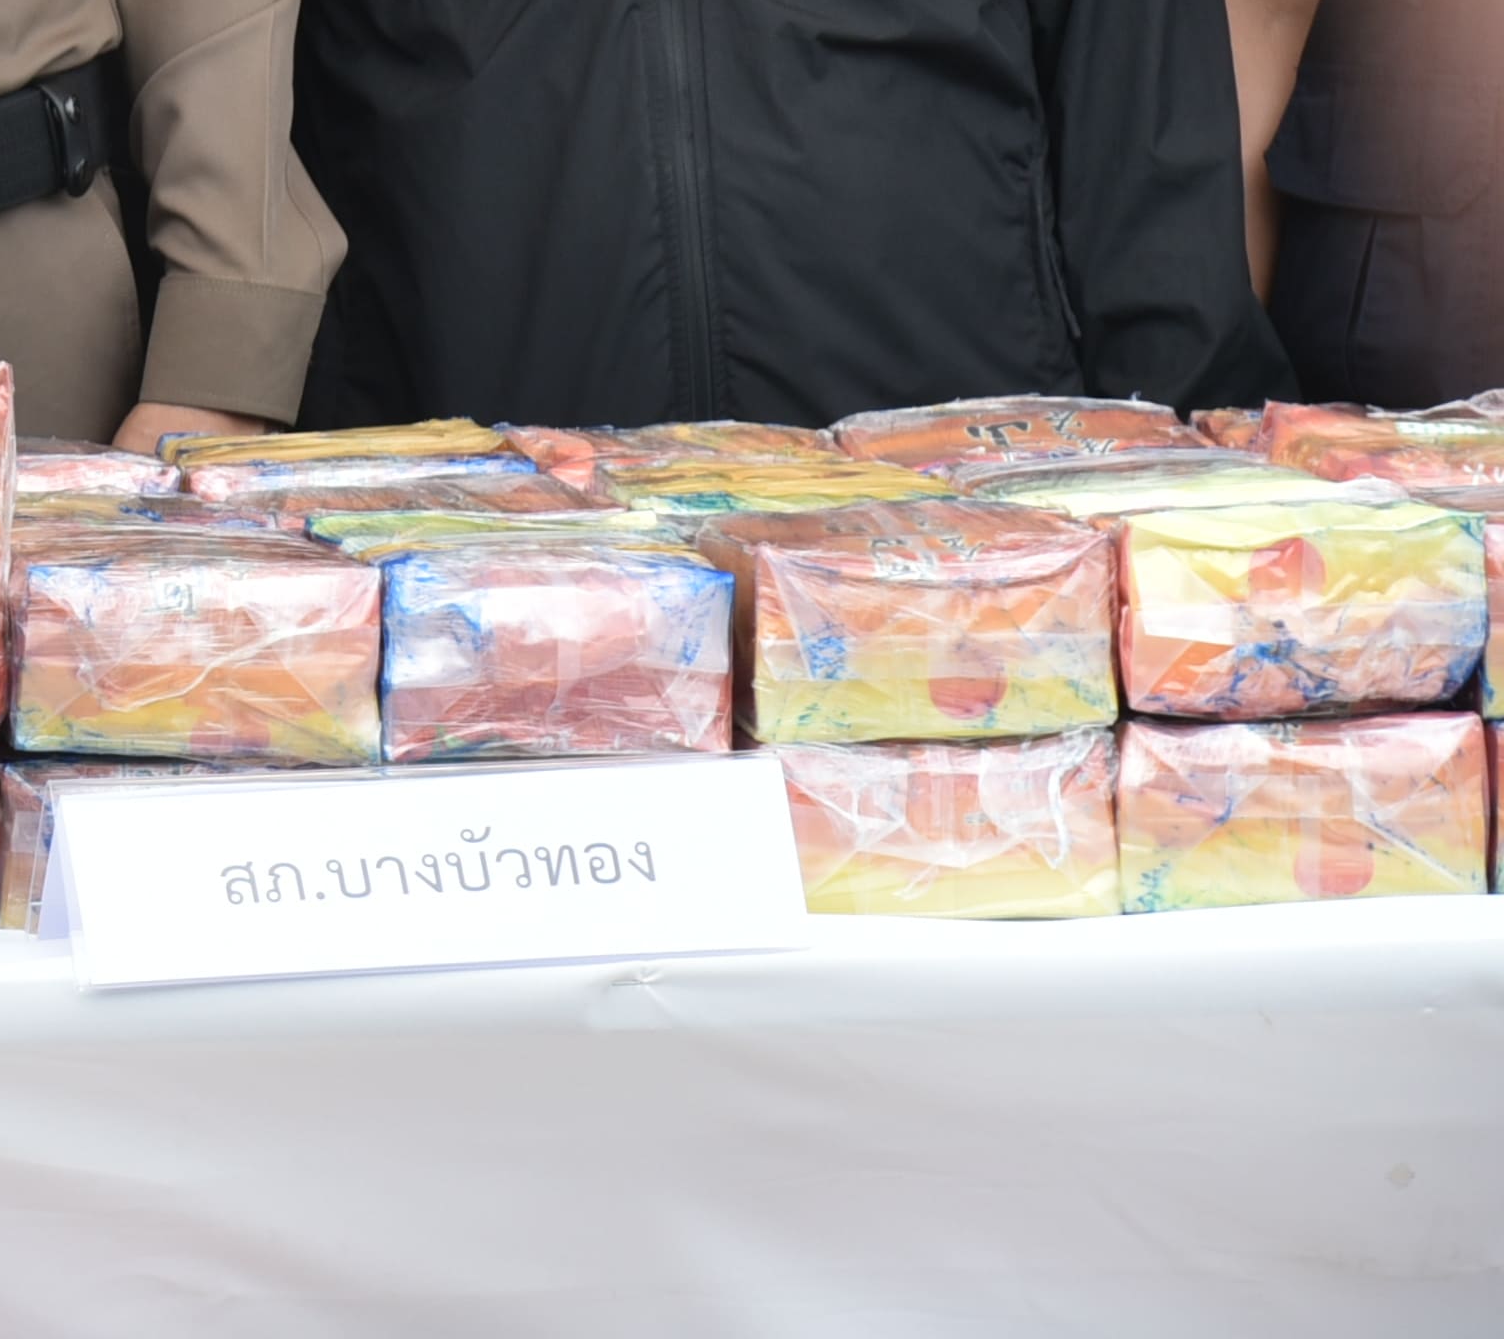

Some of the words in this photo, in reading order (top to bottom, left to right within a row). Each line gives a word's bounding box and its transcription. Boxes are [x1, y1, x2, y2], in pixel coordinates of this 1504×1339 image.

[219, 825, 658, 907] สภ.บางบัวทอง
